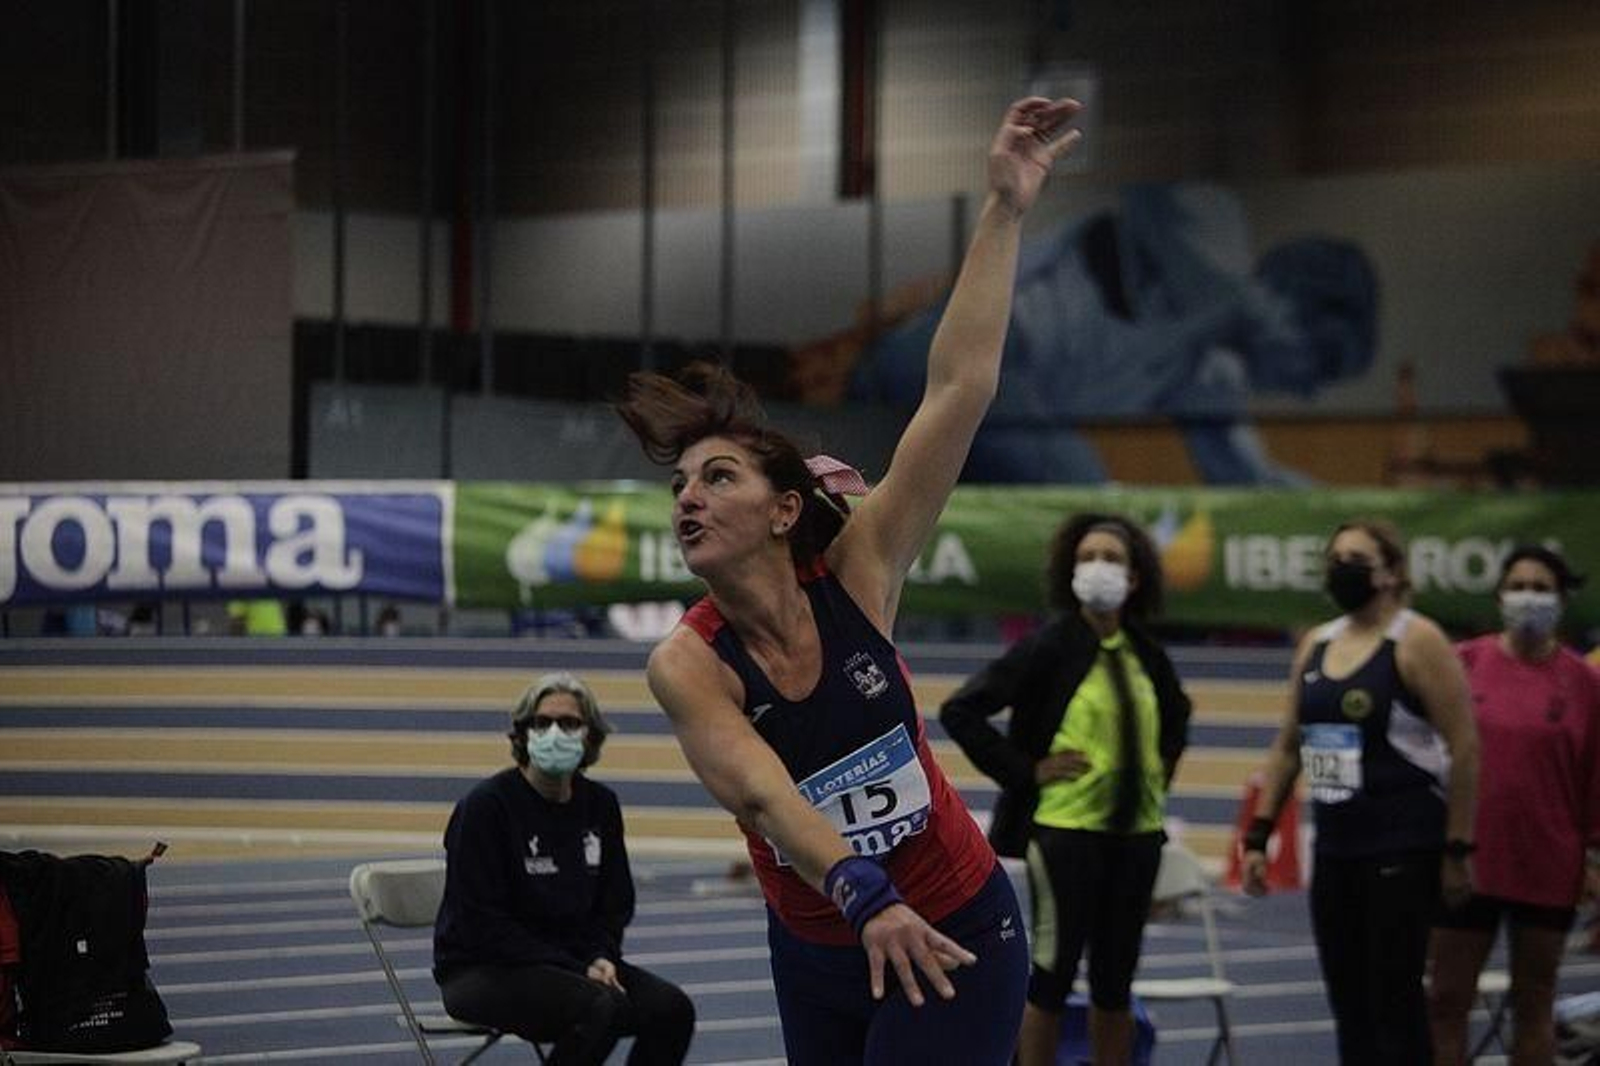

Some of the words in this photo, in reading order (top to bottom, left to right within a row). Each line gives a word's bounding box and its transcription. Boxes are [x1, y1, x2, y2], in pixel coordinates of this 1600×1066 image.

[1223, 533, 1577, 593] IBERO
[838, 778, 899, 826] 15
[849, 818, 914, 857] ma
